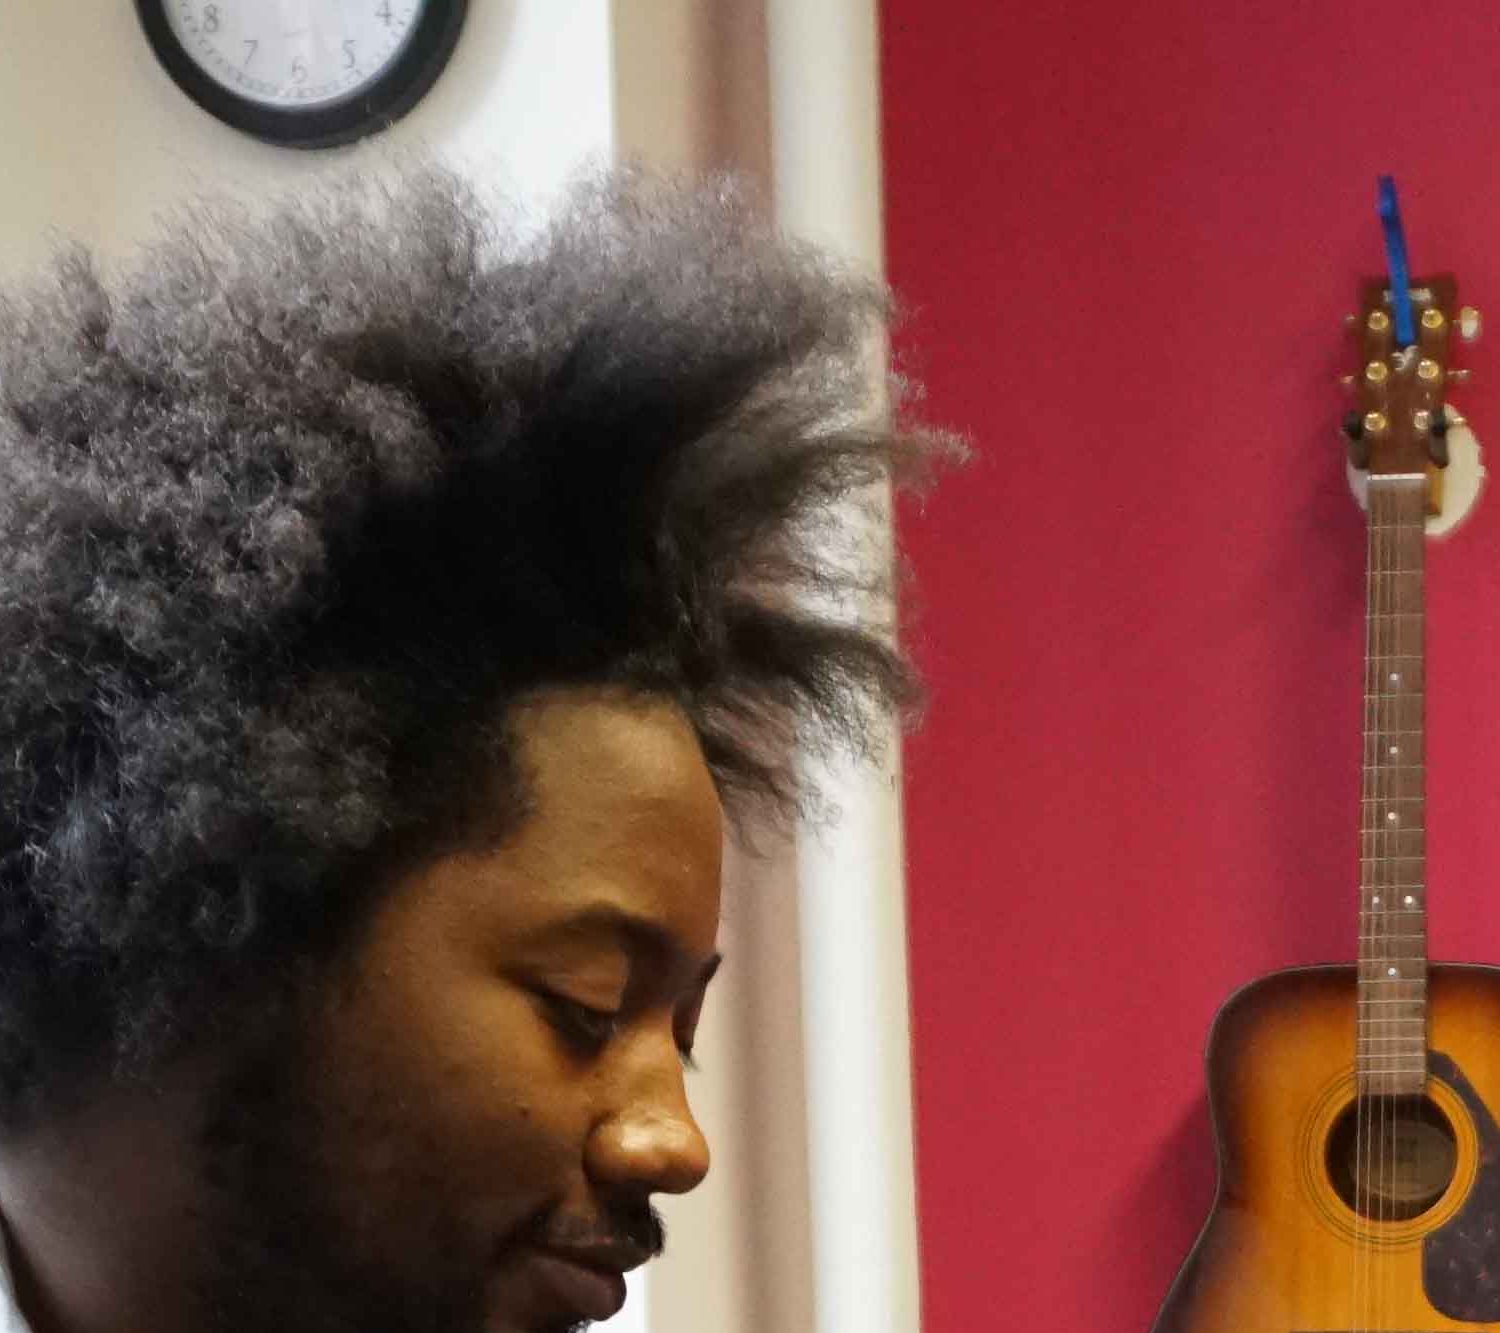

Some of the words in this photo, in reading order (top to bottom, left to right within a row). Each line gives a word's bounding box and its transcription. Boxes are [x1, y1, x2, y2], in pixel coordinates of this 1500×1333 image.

[203, 4, 219, 32] 8
[375, 0, 391, 27] 4
[244, 39, 259, 65] 7
[342, 39, 357, 68] 5
[291, 56, 308, 83] 6
